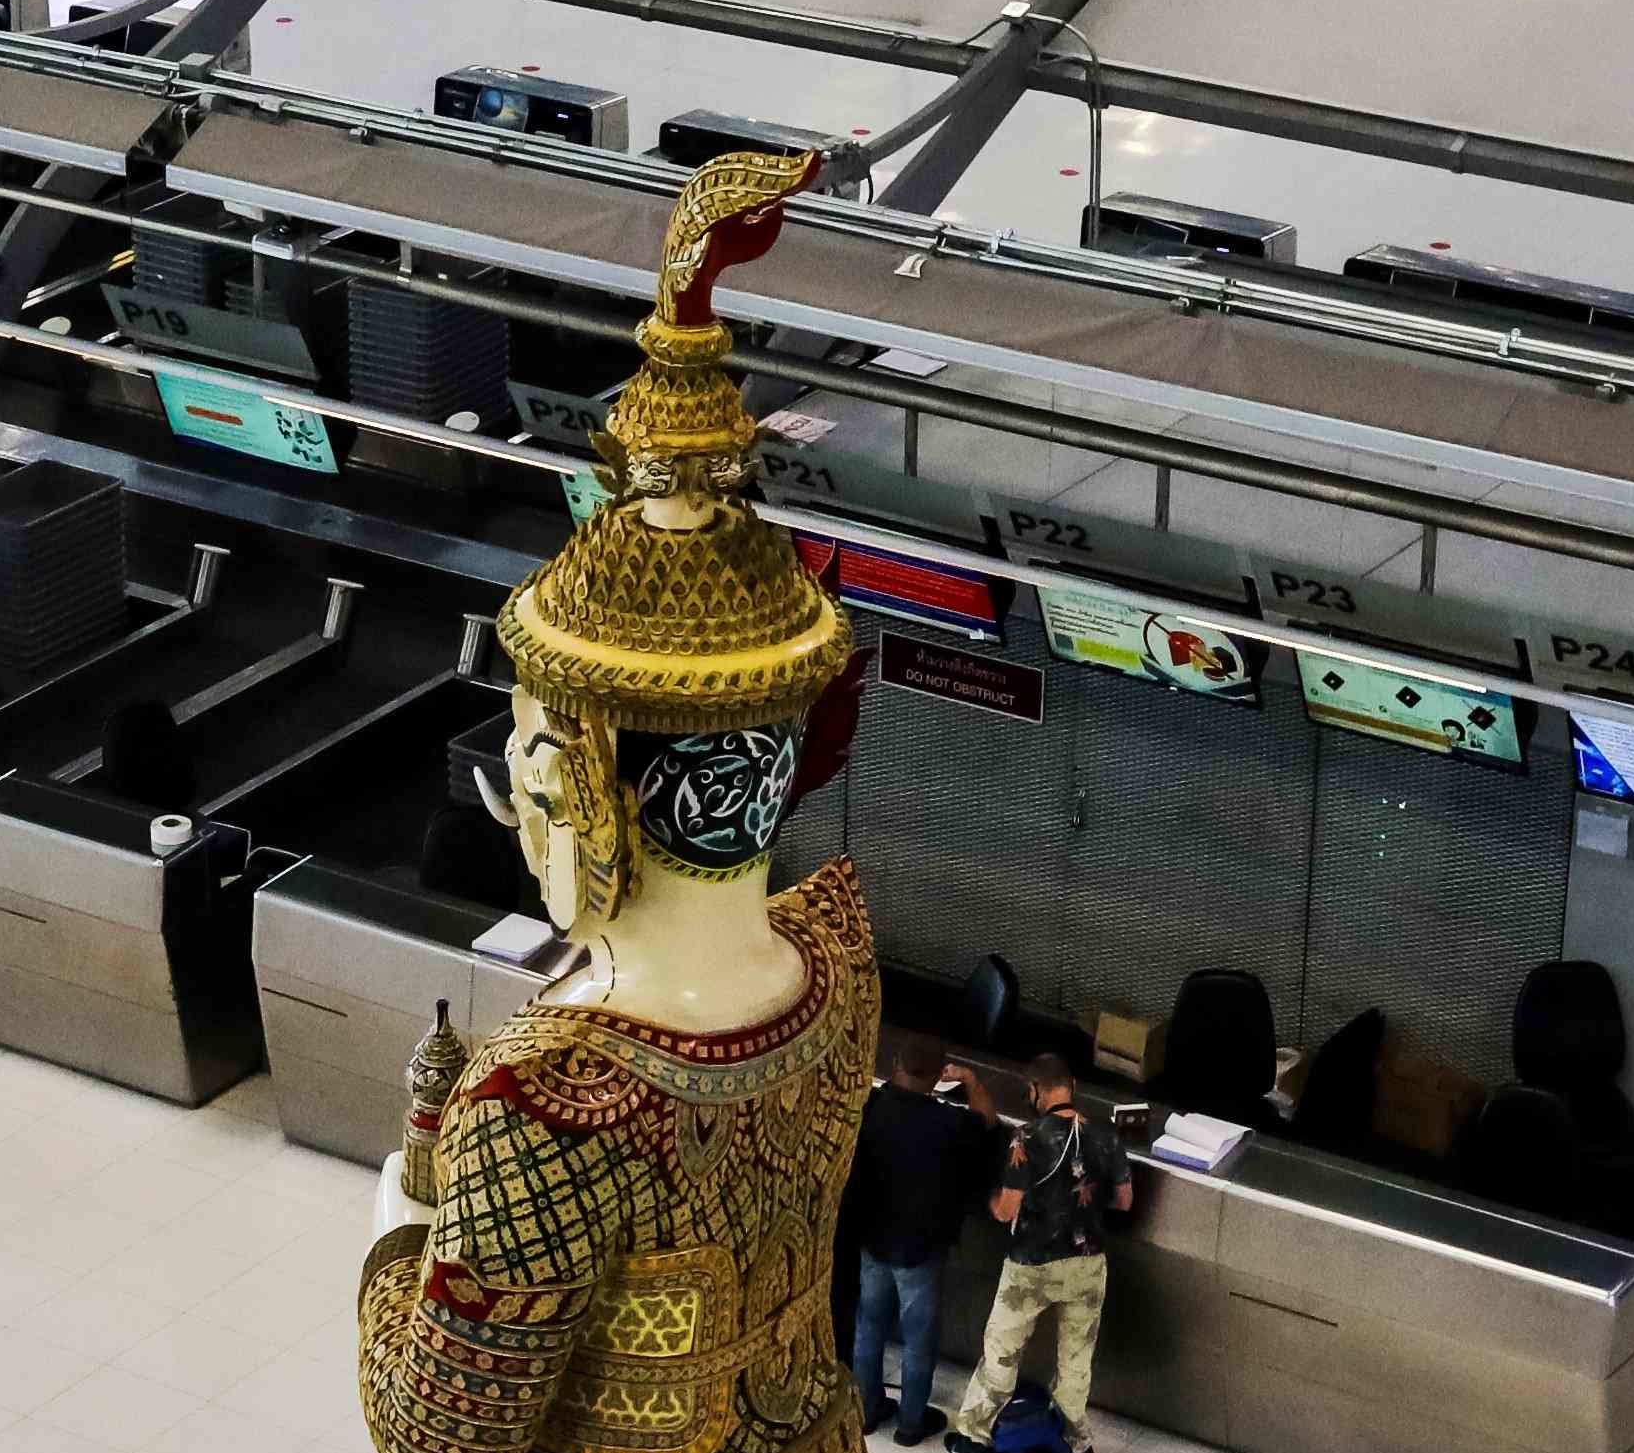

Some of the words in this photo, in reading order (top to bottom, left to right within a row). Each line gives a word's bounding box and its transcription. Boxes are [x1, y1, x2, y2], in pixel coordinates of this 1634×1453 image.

[120, 297, 187, 337] P19
[526, 397, 600, 432] P20
[761, 452, 836, 492] P21
[1008, 509, 1093, 552] P22
[1270, 571, 1358, 614] P23
[905, 668, 923, 683] DO
[926, 674, 950, 689] NOT
[953, 681, 1016, 707] OBSTRUCT
